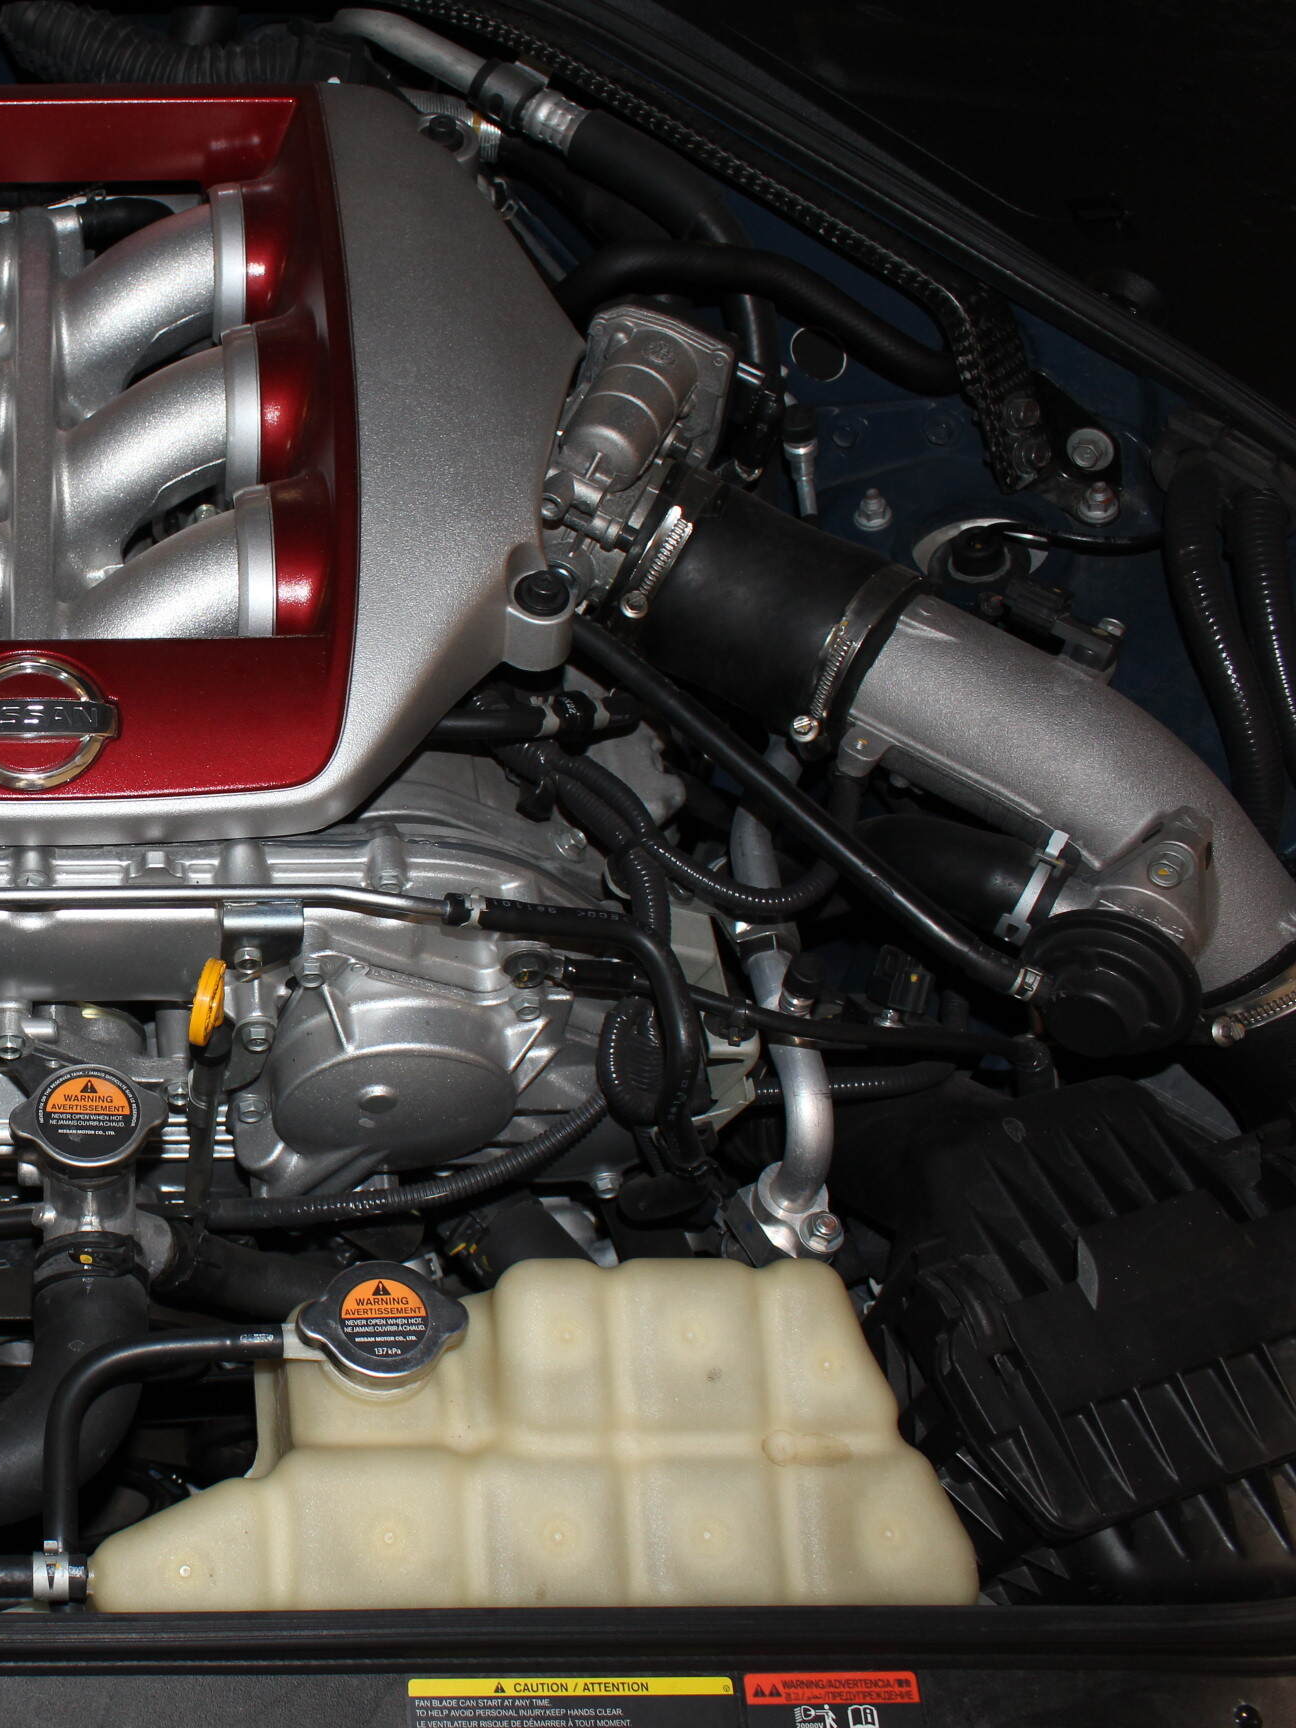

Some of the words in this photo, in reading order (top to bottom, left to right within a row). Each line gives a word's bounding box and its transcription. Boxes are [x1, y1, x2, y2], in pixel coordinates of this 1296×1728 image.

[64, 1094, 113, 1103] WARNING
[51, 1103, 125, 1112] AVERTISSEMENT
[355, 1296, 409, 1306] WARNING
[345, 1306, 422, 1315] AVERTISSEMENT
[374, 1347, 387, 1355] 137
[388, 1347, 401, 1355] kPa
[514, 1683, 568, 1693] CAUTION
[573, 1683, 578, 1692] /
[583, 1682, 648, 1692] ATTENTION
[532, 1698, 551, 1706] TIME.
[416, 1720, 427, 1728] LE
[427, 1720, 478, 1728] VENTILATEUR
[479, 1720, 509, 1728] RISQUE
[511, 1719, 522, 1727] DE
[524, 1718, 566, 1727] DÉMARRER
[568, 1718, 574, 1727] À
[575, 1719, 595, 1727] TOUT
[596, 1719, 631, 1727] MOMENT.
